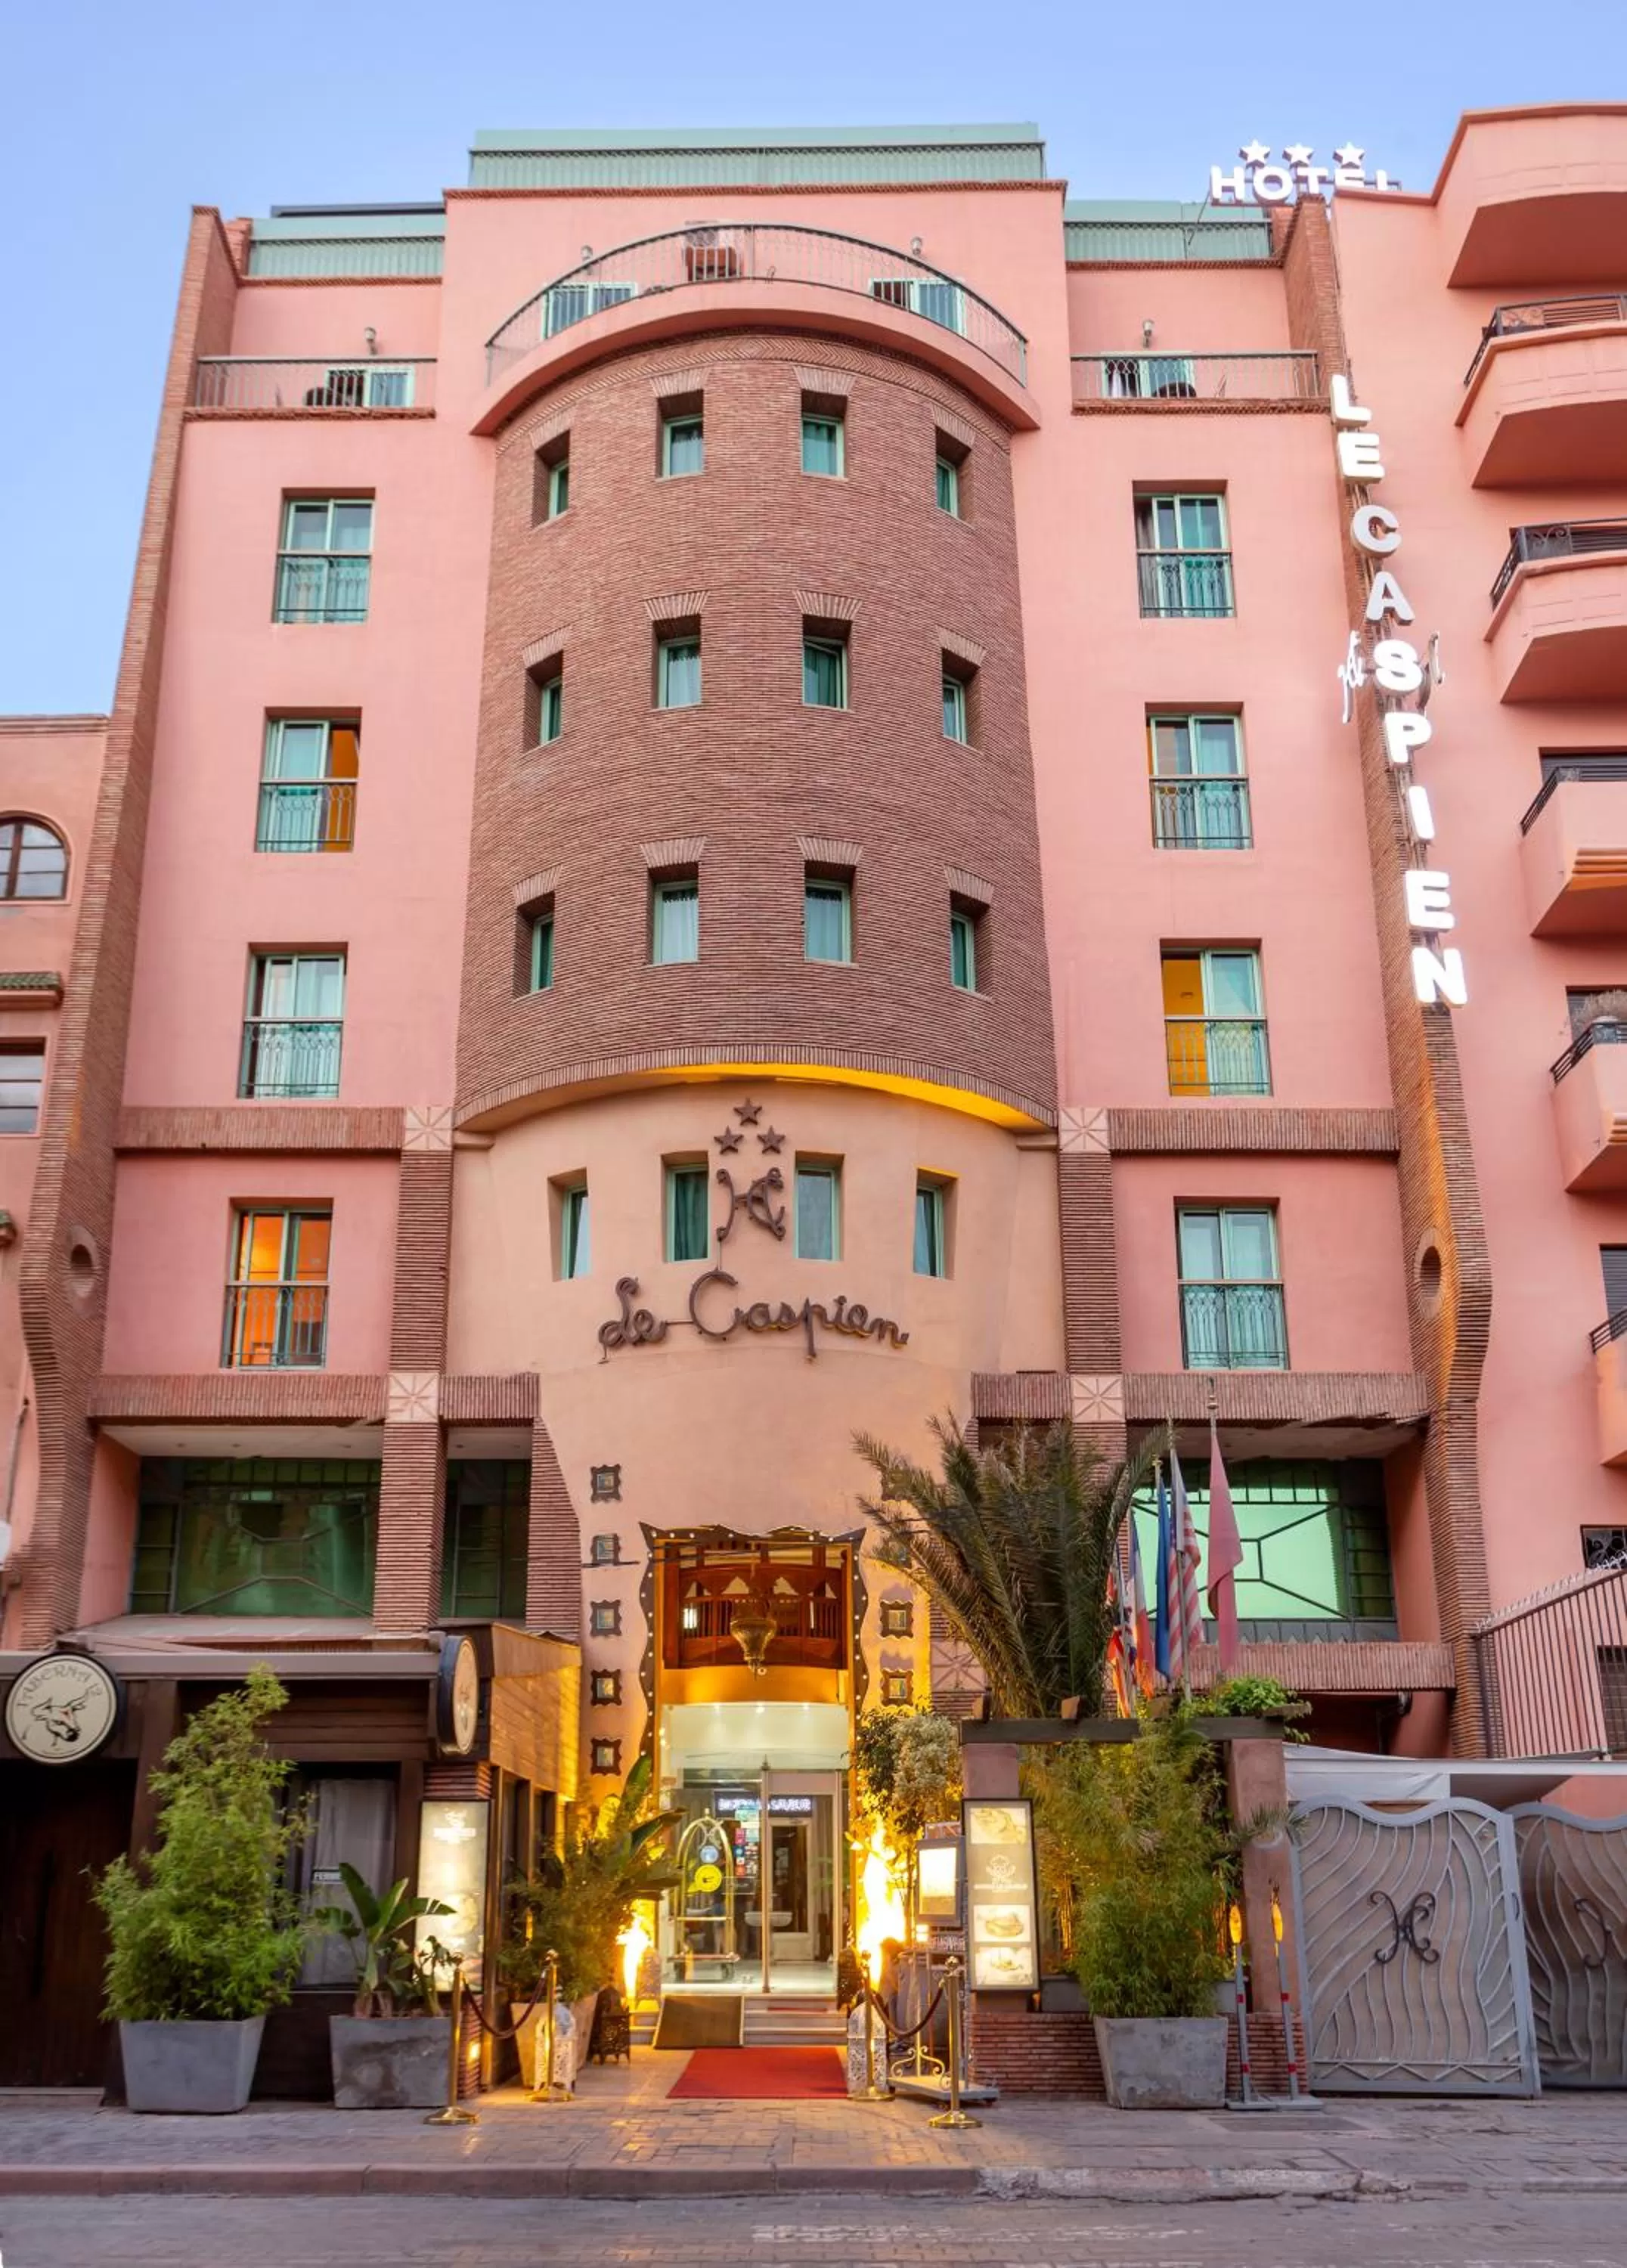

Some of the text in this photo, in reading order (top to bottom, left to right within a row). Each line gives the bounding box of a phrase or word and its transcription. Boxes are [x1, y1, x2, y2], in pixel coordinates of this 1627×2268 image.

[1330, 374, 1385, 484] LE
[1352, 504, 1467, 1008] CASPIEN
[690, 1269, 910, 1359] Caspien
